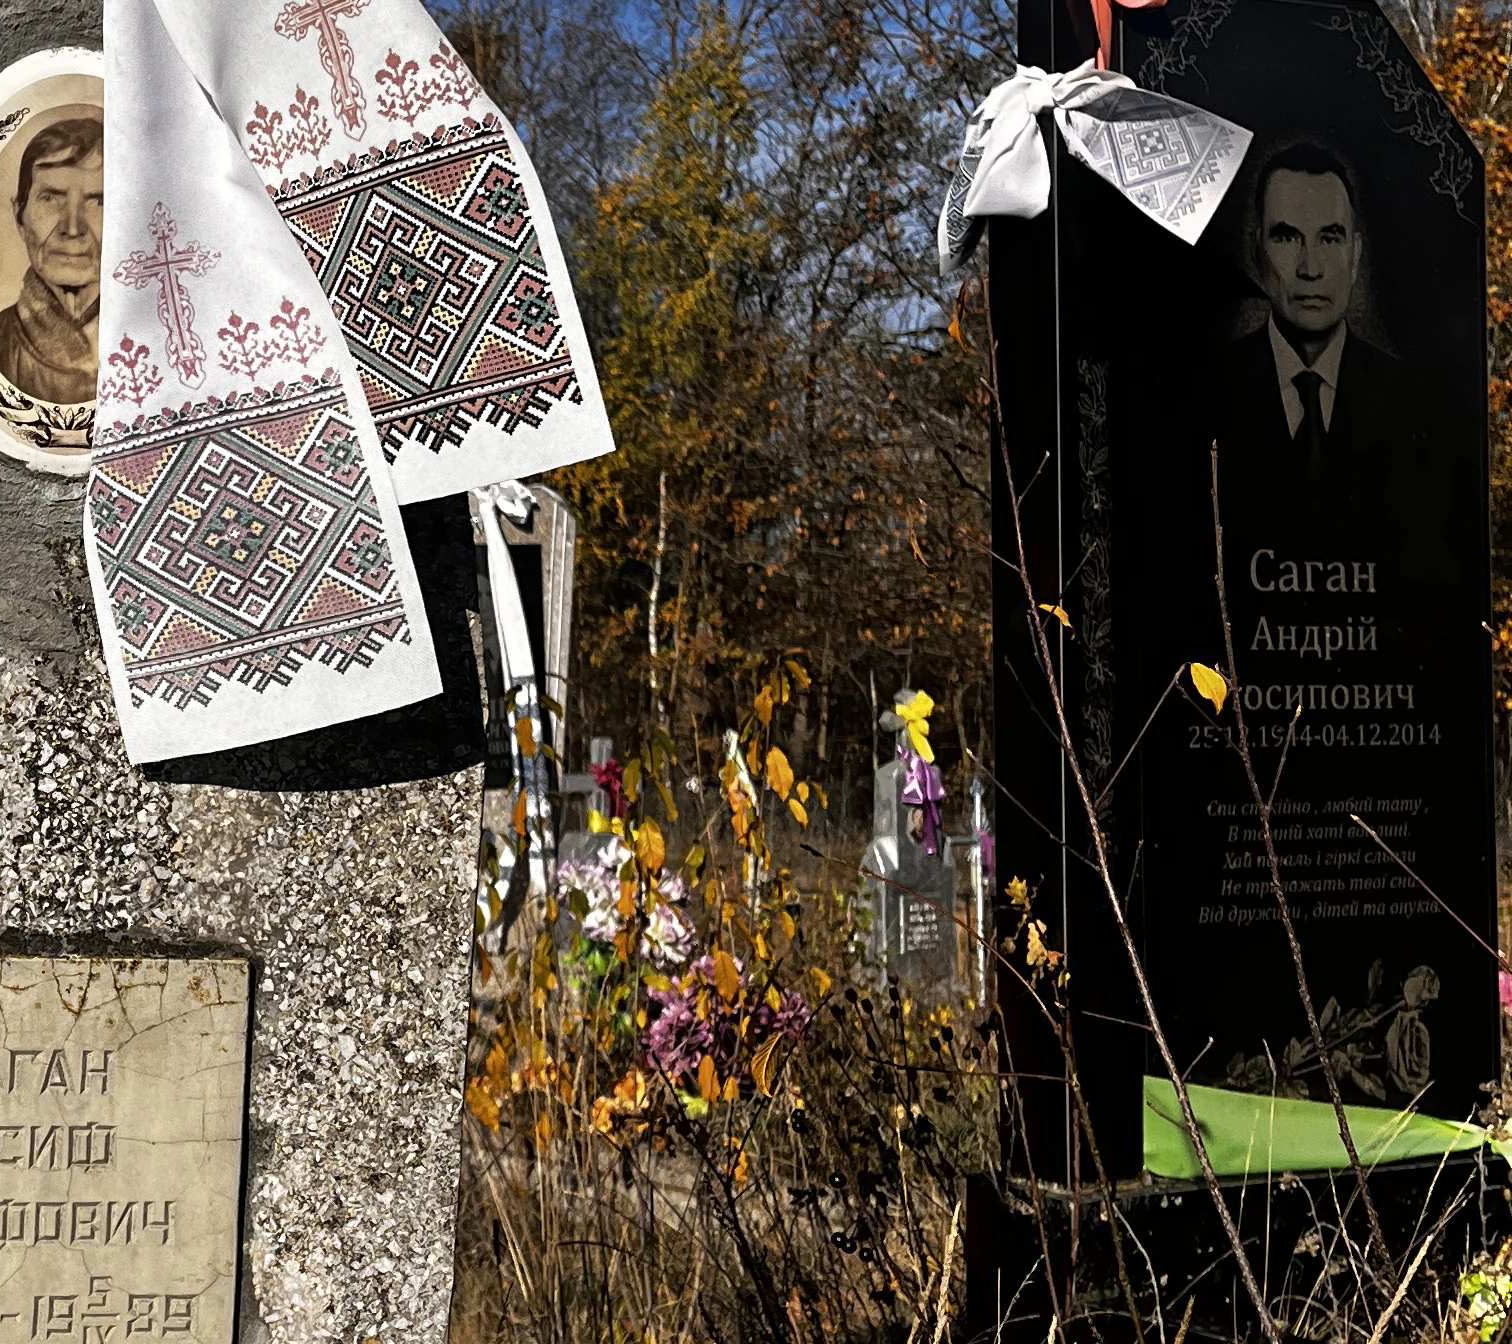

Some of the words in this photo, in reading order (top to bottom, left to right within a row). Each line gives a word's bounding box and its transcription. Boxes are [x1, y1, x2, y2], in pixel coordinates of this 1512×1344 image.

[1249, 548, 1377, 593] Саган
[1250, 616, 1378, 661] Андрій
[1231, 675, 1415, 711] осипович
[1188, 723, 1442, 749] 2512.1944-04.12.2014
[1206, 799, 1236, 816] Спи
[1322, 796, 1374, 814] любий
[1228, 825, 1239, 842] В
[1306, 822, 1343, 840] хаті
[1222, 851, 1252, 870] Хай
[1221, 879, 1241, 896] Не
[1349, 872, 1388, 892] твої
[1199, 905, 1224, 924] Від
[1312, 899, 1359, 919] дітей
[1363, 901, 1386, 916] та
